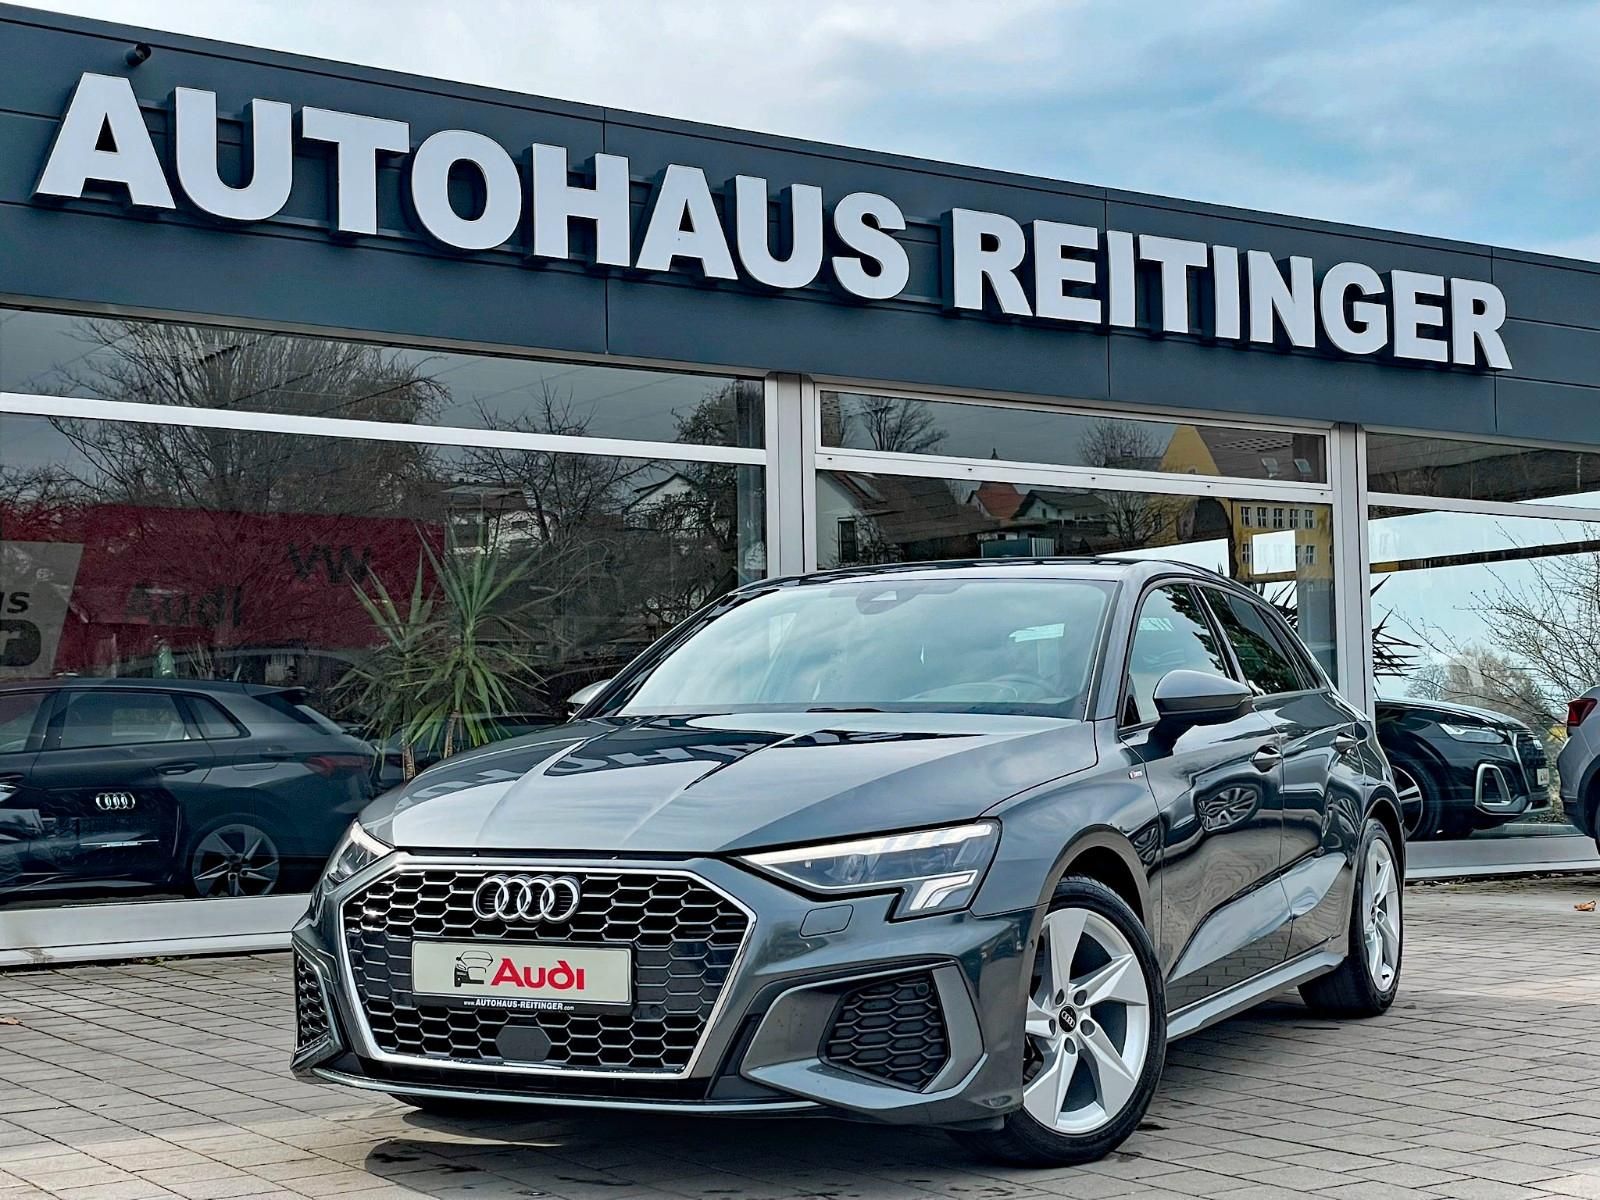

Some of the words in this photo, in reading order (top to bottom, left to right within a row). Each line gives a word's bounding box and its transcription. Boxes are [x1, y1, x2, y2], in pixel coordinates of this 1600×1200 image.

[36, 72, 910, 301] AUTOHAUS
[952, 206, 1513, 371] REITINGER
[490, 957, 585, 990] Audi
[463, 998, 575, 1012] www.AUTOHAUS-REITINGER.com
